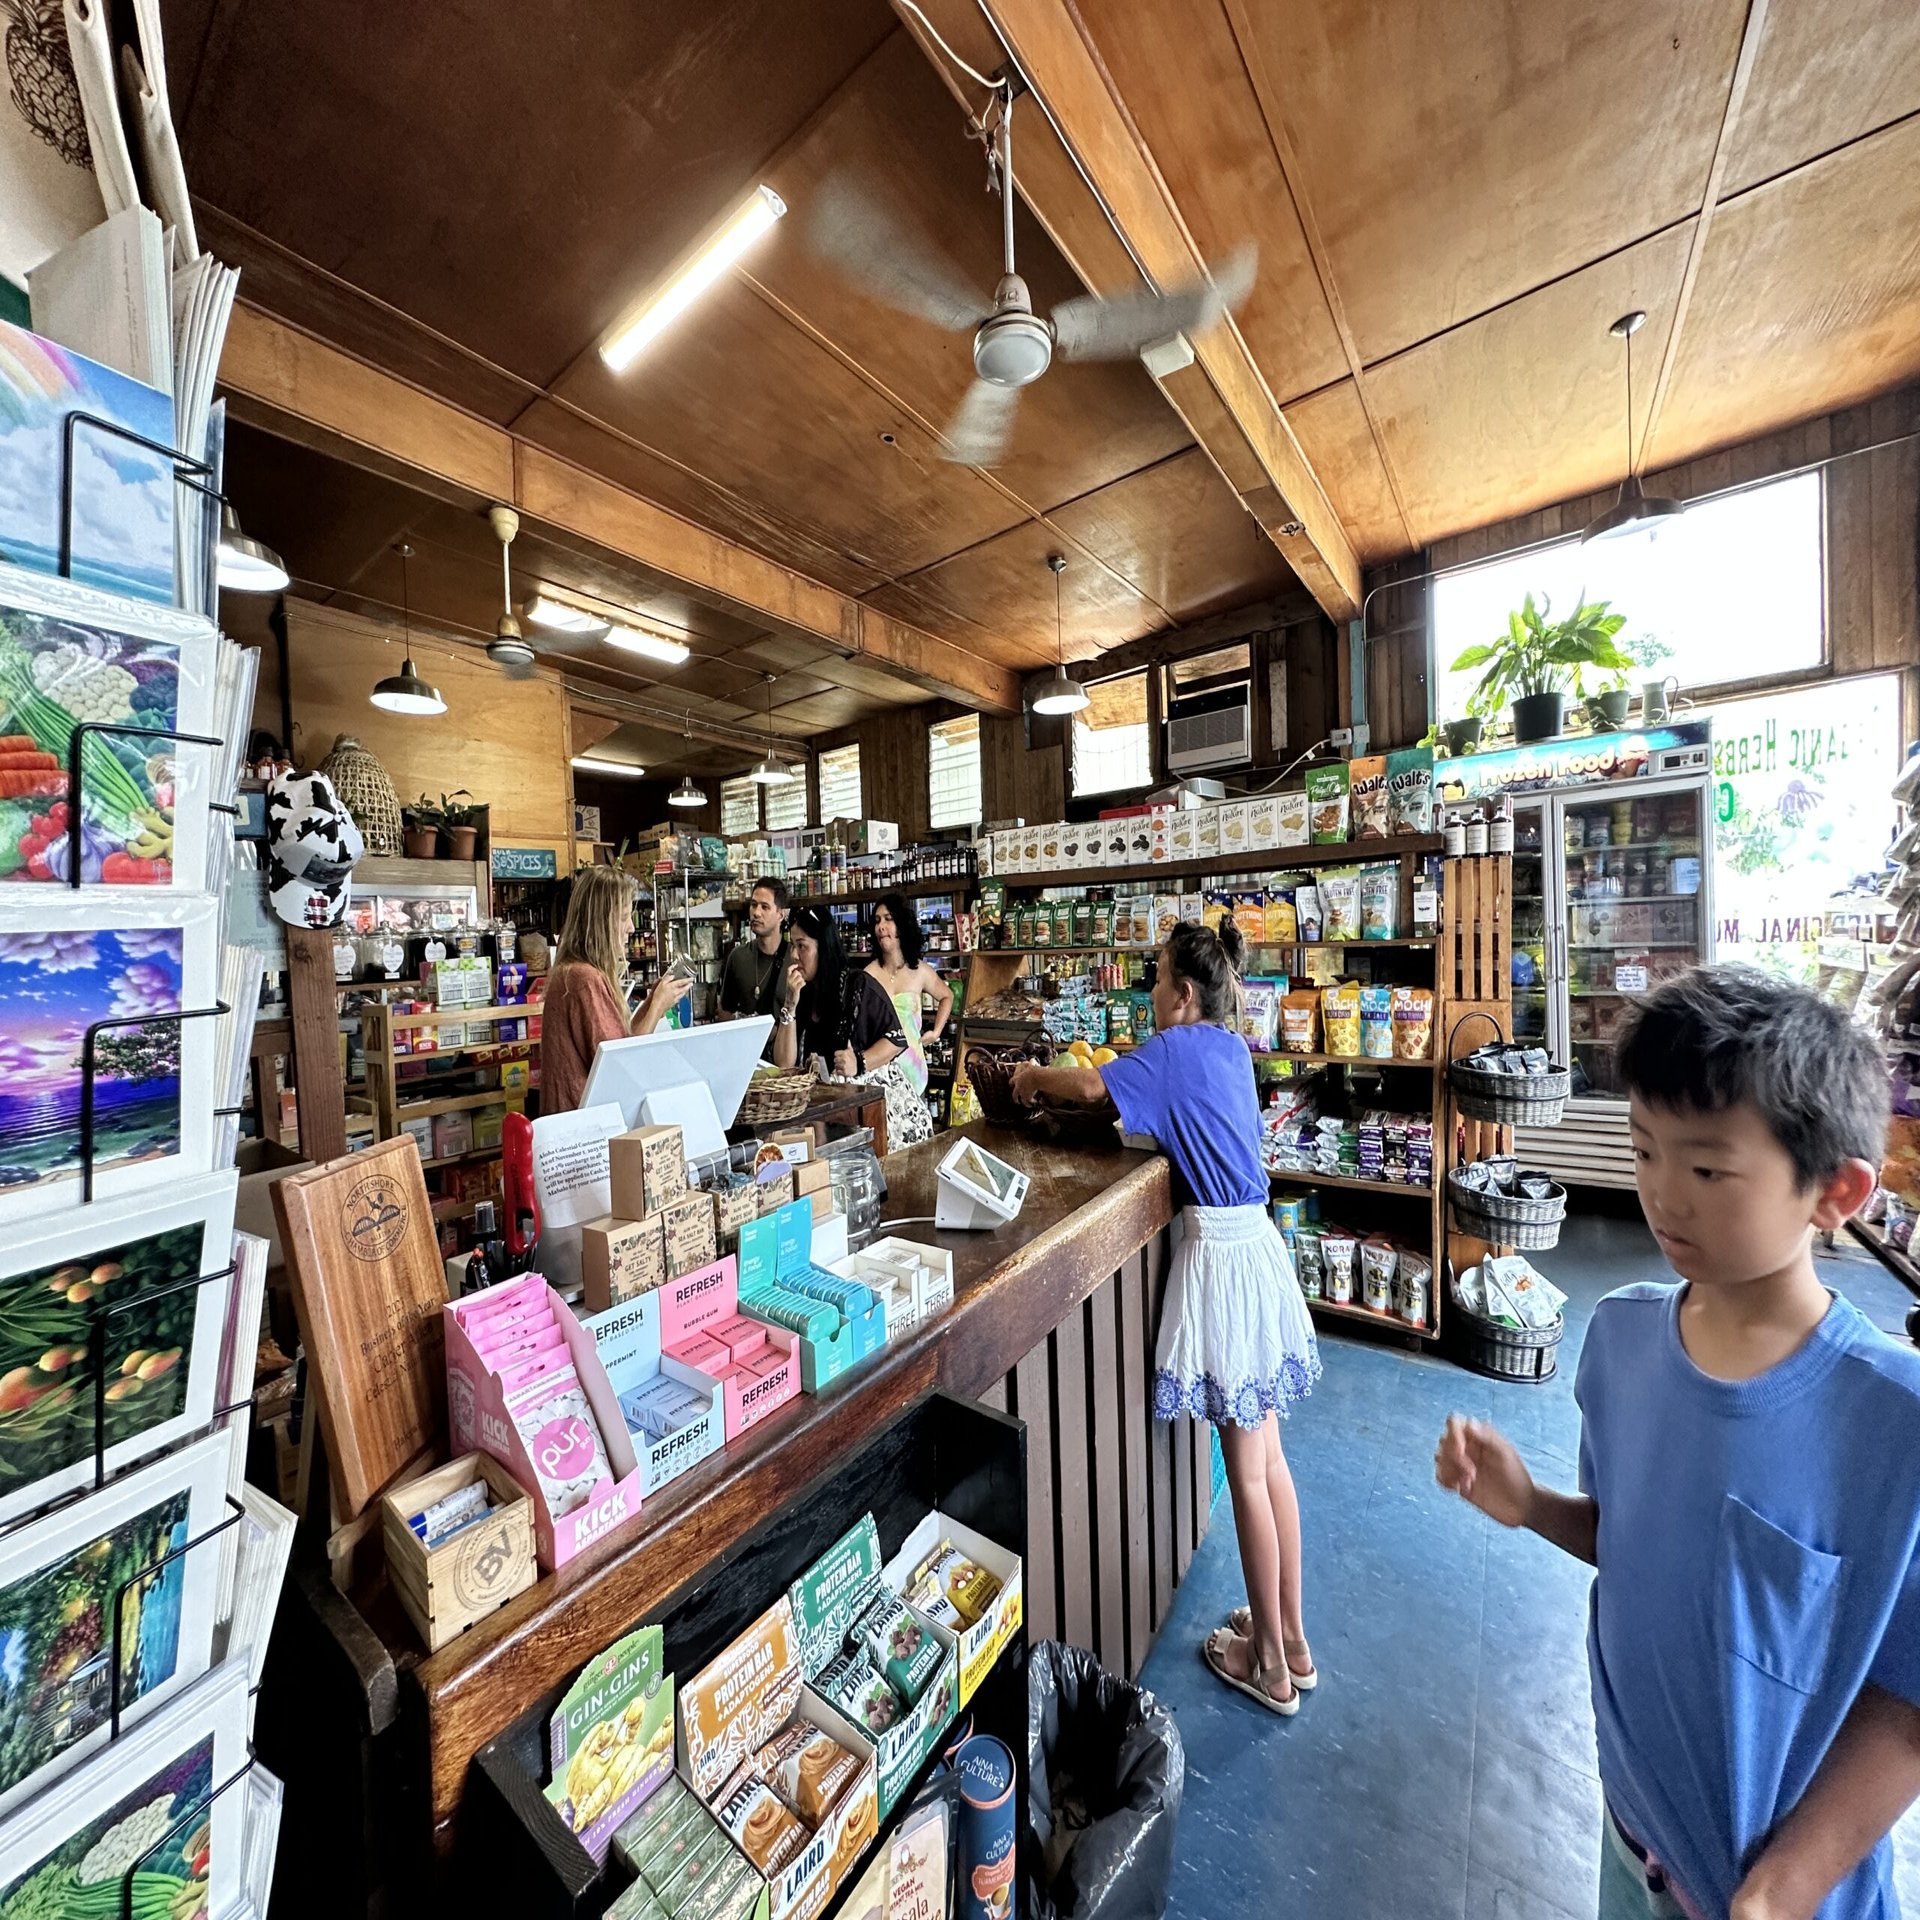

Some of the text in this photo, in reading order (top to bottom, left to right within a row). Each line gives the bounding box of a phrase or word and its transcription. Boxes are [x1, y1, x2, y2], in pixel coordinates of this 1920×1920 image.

[1390, 769, 1432, 793] Walt's
[1479, 746, 1618, 788] Frozen Food
[507, 855, 541, 870] SPICES
[1394, 1001, 1431, 1012] MOCHI
[555, 1143, 578, 1153] Celestial
[555, 1151, 582, 1161] November
[564, 1157, 589, 1167] surcharge
[543, 1172, 562, 1182] Credit
[562, 1168, 575, 1176] Card
[545, 1181, 557, 1190] will
[564, 1173, 583, 1184] applied
[547, 1185, 568, 1197] Mahalo
[577, 1180, 589, 1189] your
[346, 1178, 396, 1211] NORTH SHORE
[1326, 1244, 1351, 1254] NORA
[1365, 1250, 1392, 1262] NORA
[624, 1256, 652, 1273] GET SALTY
[676, 1270, 723, 1303] REFRESH
[676, 1283, 724, 1309] PLANT BASED GUM
[925, 1286, 950, 1316] THREE
[596, 1308, 643, 1341] EFRESH
[609, 1328, 630, 1343] BASED
[630, 1322, 644, 1333] GUM
[683, 1308, 719, 1330] BUBBLE GUM
[887, 1308, 916, 1339] THREE
[360, 1327, 396, 1356] Business
[605, 1350, 637, 1370] PPERMINT
[742, 1367, 788, 1407] REFRESH
[482, 1412, 508, 1447] KICK
[651, 1418, 709, 1465] REFRESH
[651, 1432, 710, 1472] PLANT BASED GUM
[574, 1486, 628, 1543] KICK
[473, 1524, 513, 1587] BV
[815, 1558, 848, 1604] PROTEIN
[846, 1550, 862, 1574] BAR
[871, 1600, 904, 1640] LAIRD
[969, 1613, 994, 1655] LAIRD
[905, 1655, 929, 1684] PROTEIN
[964, 1638, 996, 1686] PROTEIN BAR
[582, 1669, 604, 1691] ginger
[713, 1656, 756, 1712] PROTEIN
[755, 1642, 775, 1672] BAR
[779, 1667, 798, 1690] BUTTER
[841, 1665, 875, 1704] LAIRD
[717, 1661, 776, 1723] +ADAPTOGENS
[892, 1713, 921, 1761] LAIRD
[695, 1747, 717, 1776] LAIRD
[960, 1760, 999, 1788] CULTURE
[817, 1764, 845, 1796] PROTEIN
[608, 1767, 659, 1823] FRESH GINGER
[720, 1775, 763, 1829] LAIRD
[763, 1835, 793, 1876] PROTEIN
[985, 1839, 1012, 1860] CULTURE
[786, 1839, 825, 1903] LAIRD
[893, 1876, 915, 1899] VEGAN
[905, 1881, 925, 1898] TEA MIX
